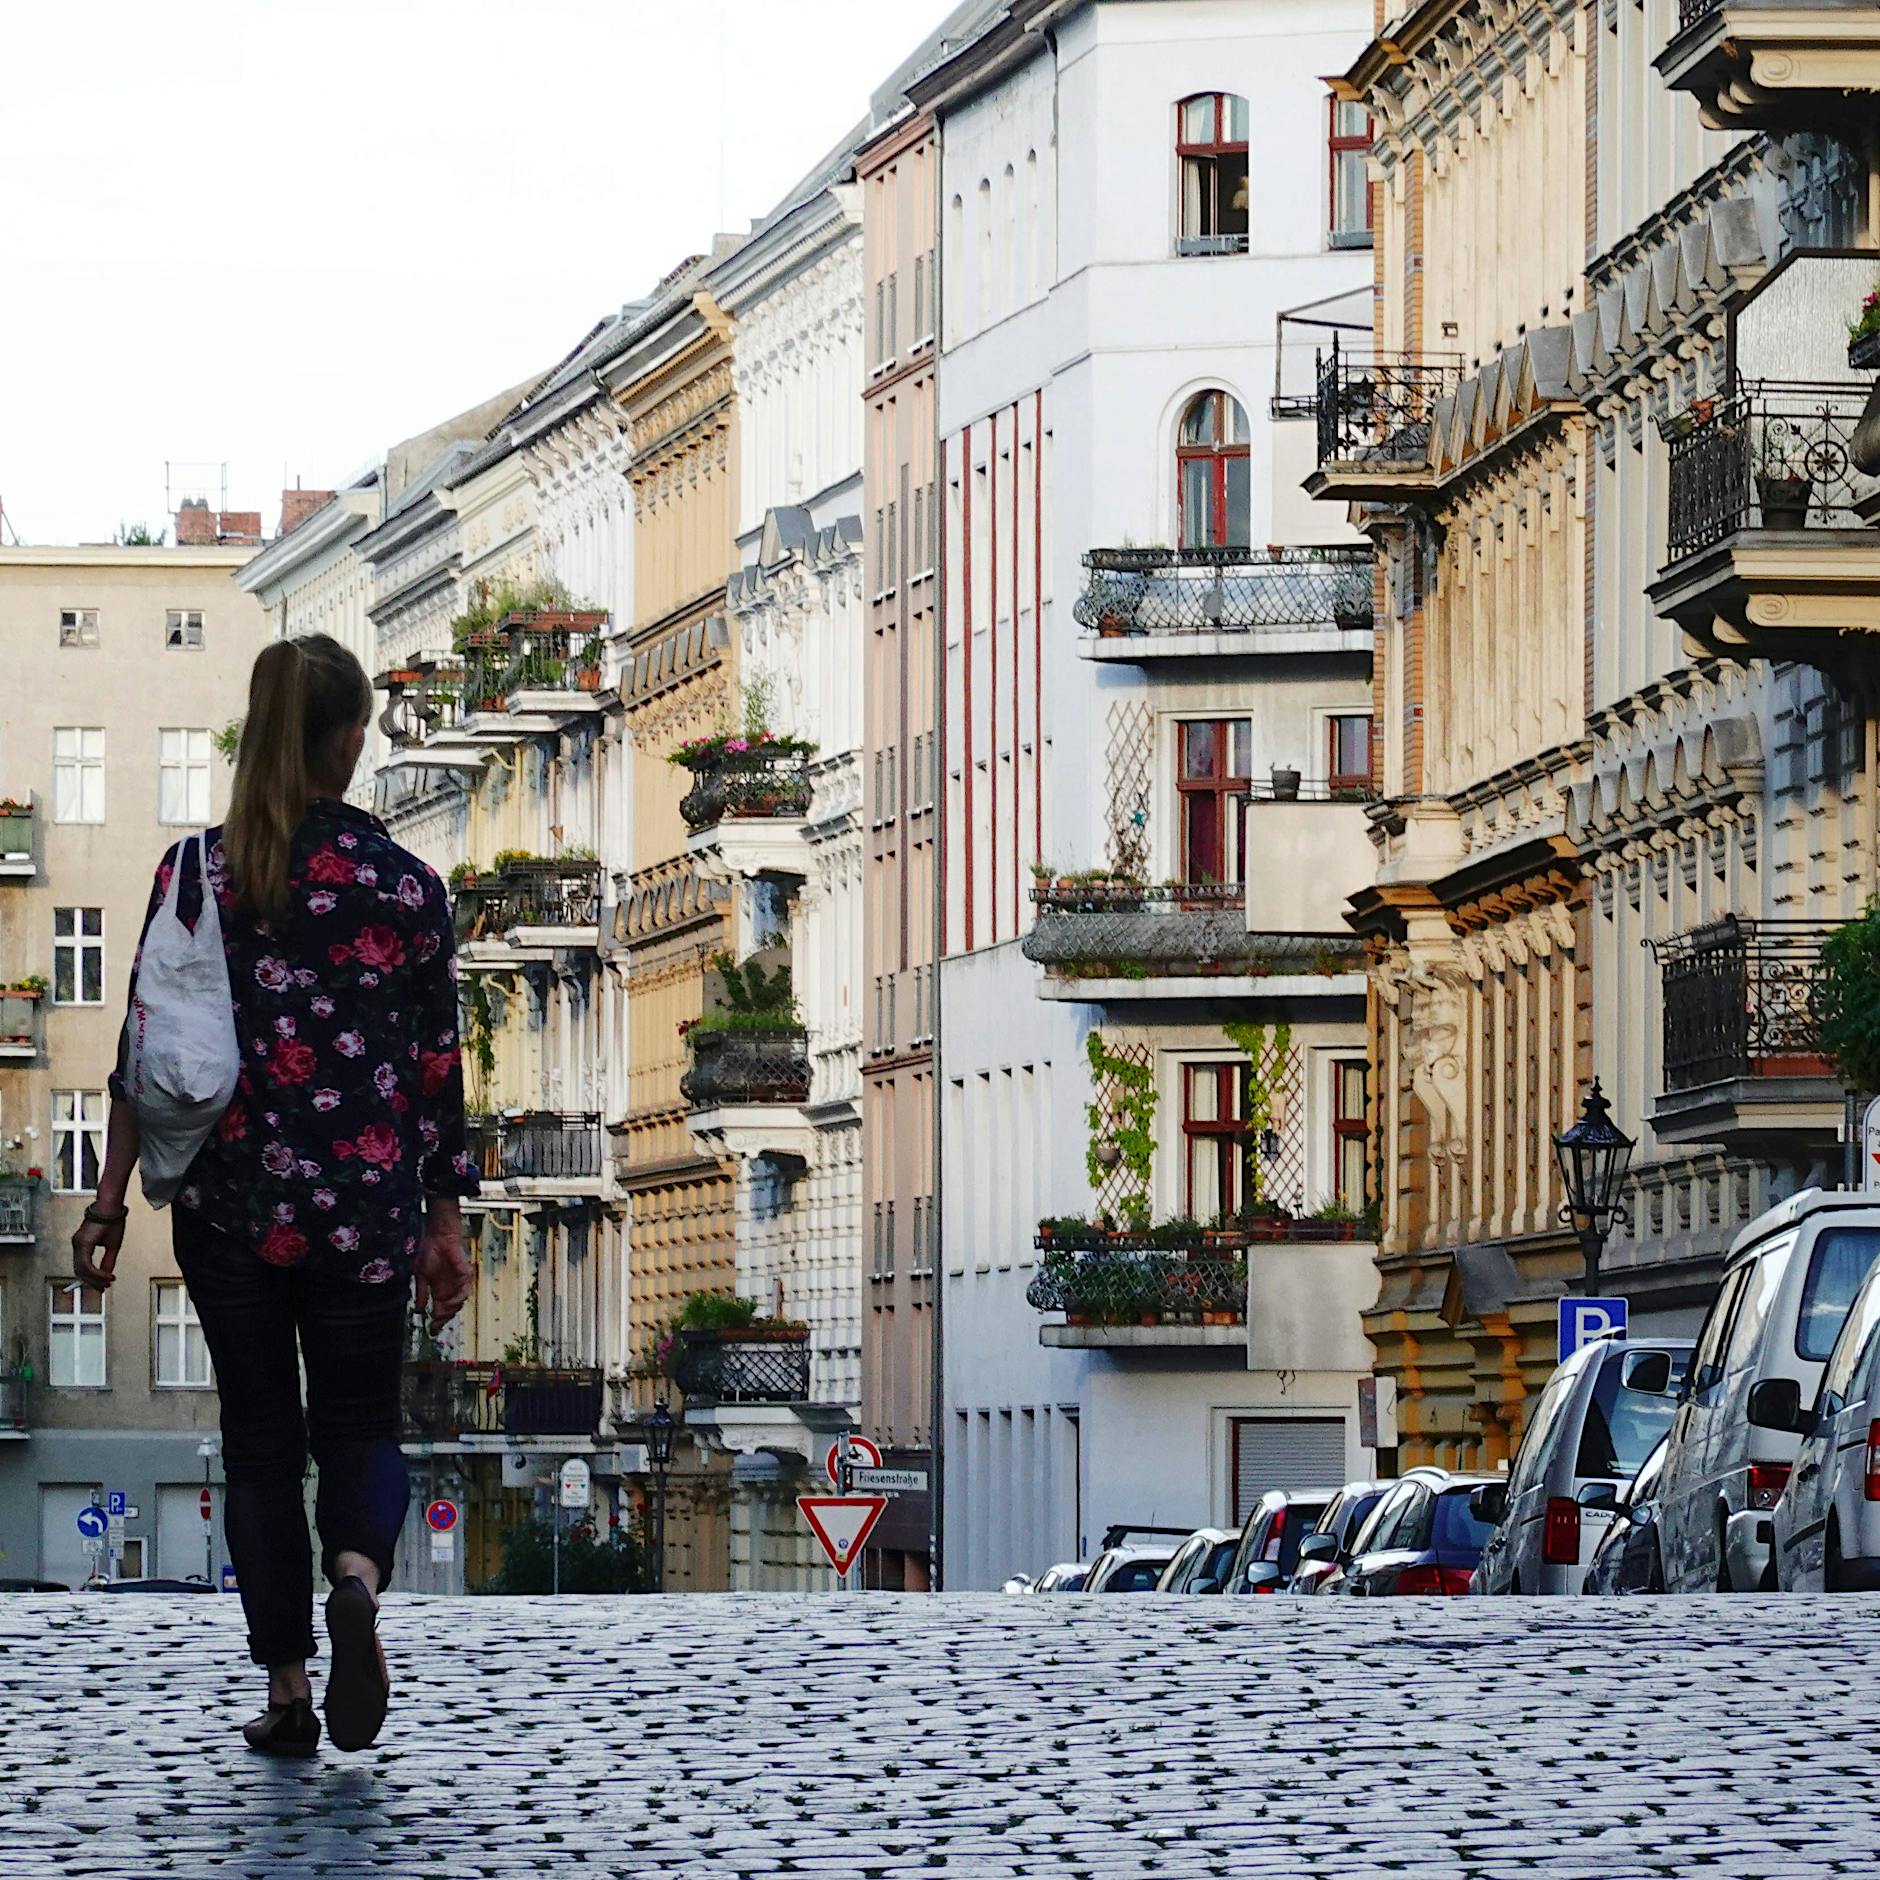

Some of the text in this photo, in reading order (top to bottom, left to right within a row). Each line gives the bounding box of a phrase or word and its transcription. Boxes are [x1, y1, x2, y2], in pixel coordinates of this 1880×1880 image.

[1576, 1307, 1611, 1352] P
[859, 1471, 919, 1487] Friesenstraße
[111, 1494, 121, 1513] P
